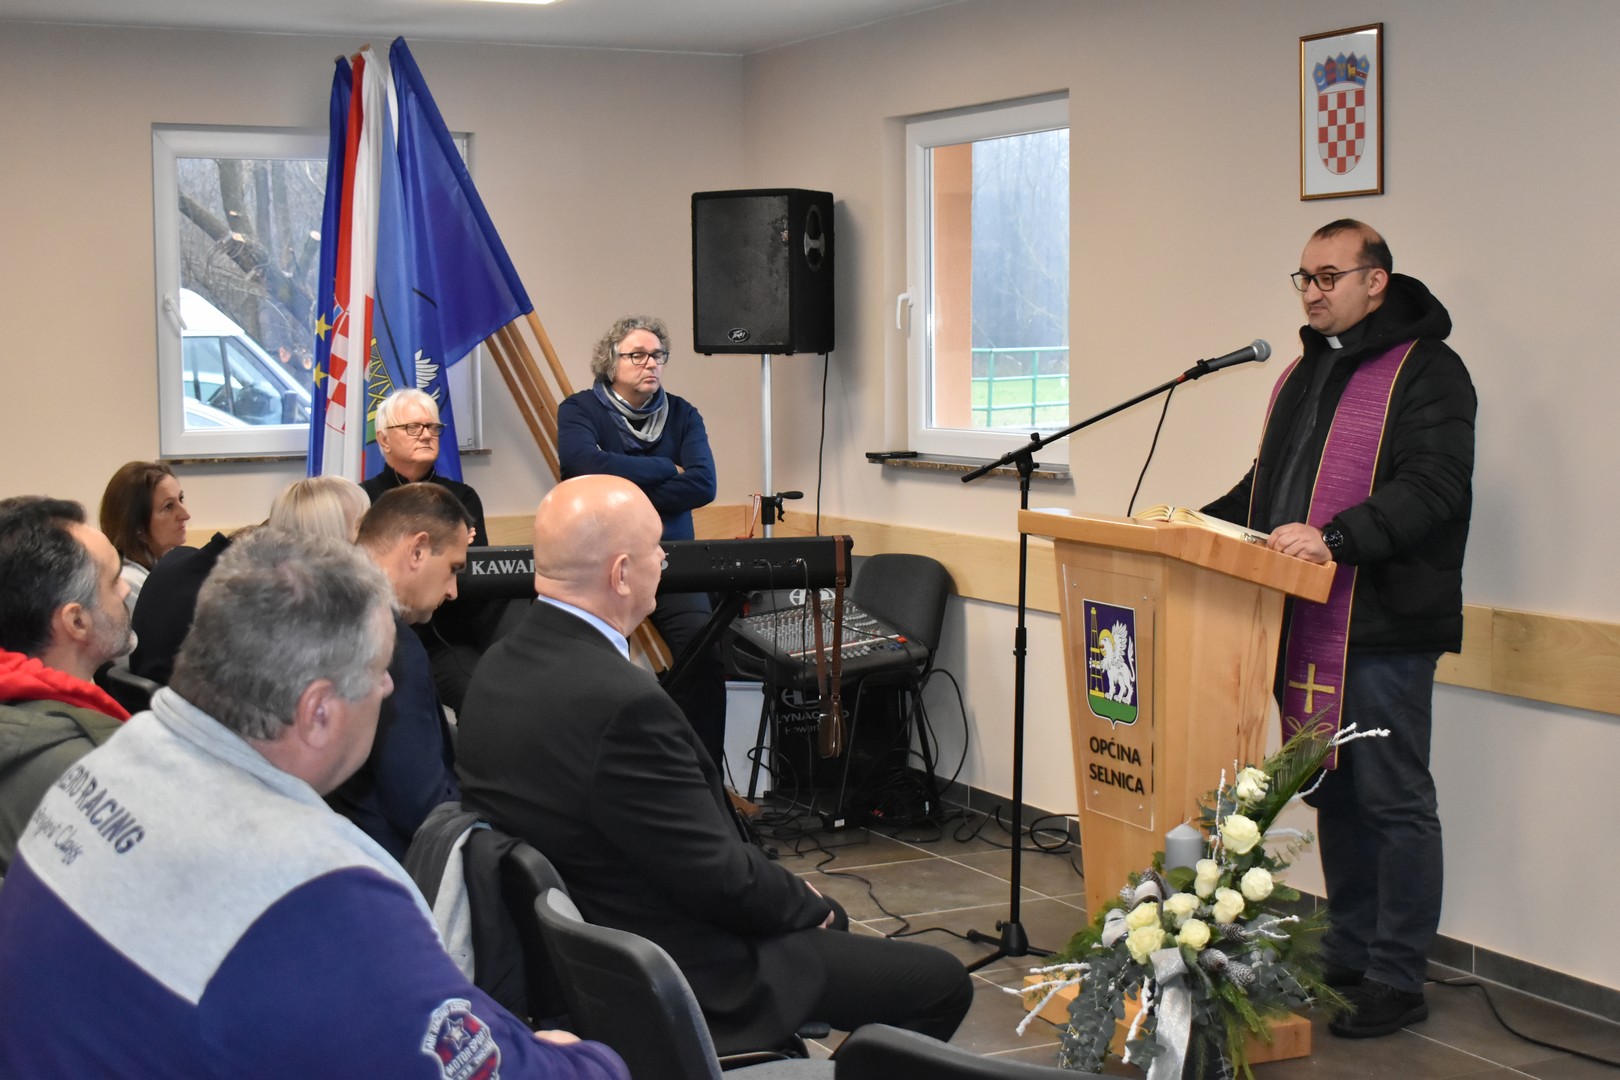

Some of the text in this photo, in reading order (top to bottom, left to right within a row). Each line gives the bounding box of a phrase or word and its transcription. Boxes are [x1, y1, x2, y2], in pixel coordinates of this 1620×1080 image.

[472, 559, 535, 575] KAWAI
[1089, 736, 1142, 767] OPĆINA
[1089, 763, 1145, 796] SELNICA
[75, 776, 145, 854] RACING
